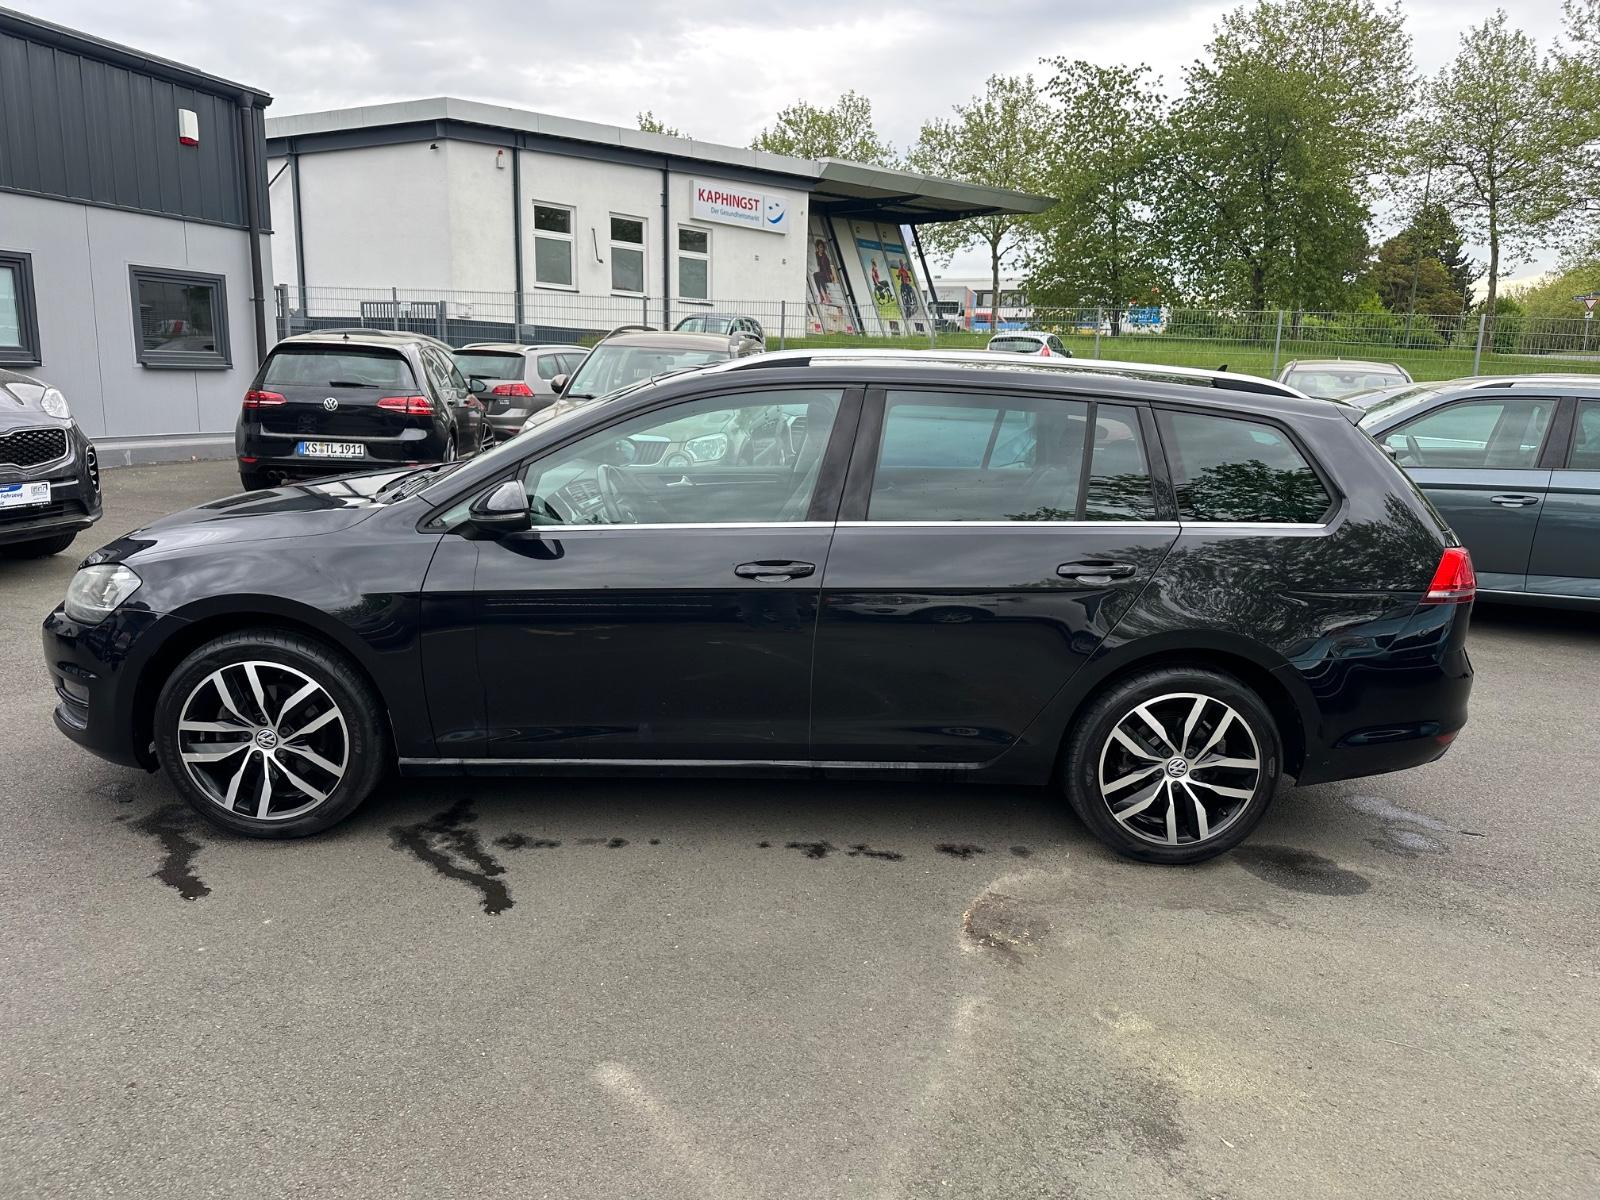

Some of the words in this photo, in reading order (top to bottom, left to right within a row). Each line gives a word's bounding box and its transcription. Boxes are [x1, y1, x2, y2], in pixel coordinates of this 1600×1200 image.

[698, 188, 760, 211] KAPHINGST
[710, 207, 720, 215] Der
[304, 443, 318, 454] KS
[324, 444, 337, 454] TL
[339, 444, 363, 455] 1911
